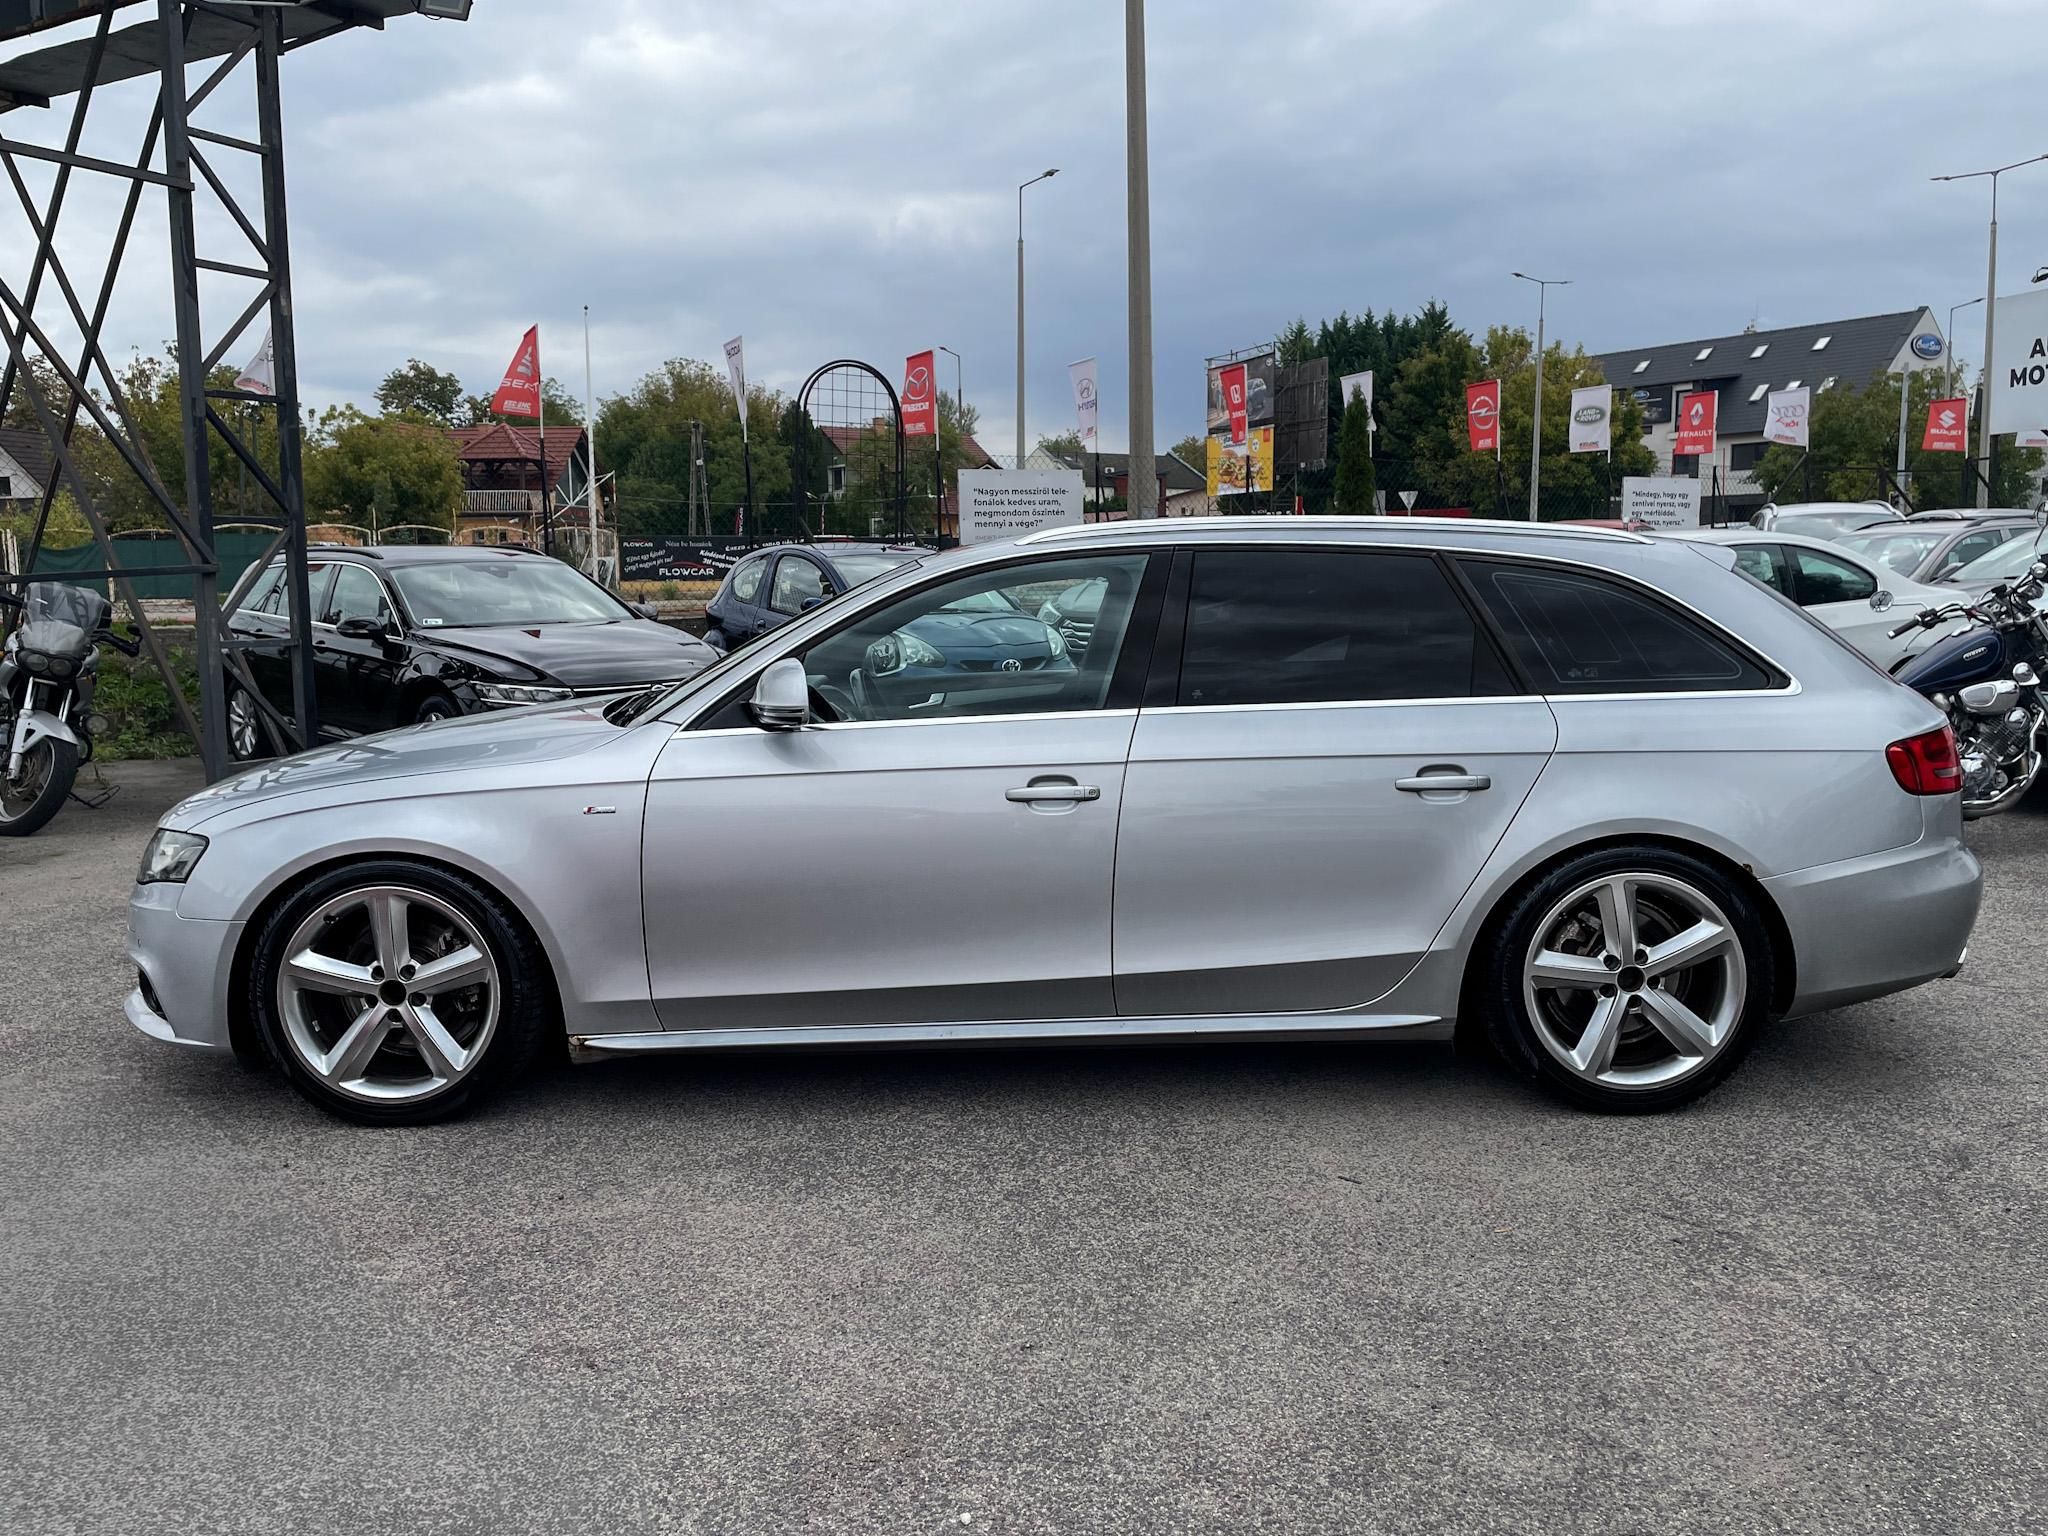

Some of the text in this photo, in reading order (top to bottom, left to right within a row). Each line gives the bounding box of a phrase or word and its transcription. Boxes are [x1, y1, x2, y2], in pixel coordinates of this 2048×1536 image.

[2029, 337, 2048, 359] A
[501, 378, 539, 393] SEAT
[1680, 429, 1712, 438] RENAULT
[1051, 487, 1069, 495] tele-
[1662, 491, 1677, 500] hogy
[974, 497, 1061, 507] fonálok kedves uram,
[1677, 501, 1691, 509] vagy
[974, 507, 1065, 519] megmondom őszintén
[1631, 510, 1643, 518] egy
[974, 519, 1006, 529] mennyi
[658, 567, 715, 576] FLOWCAR
